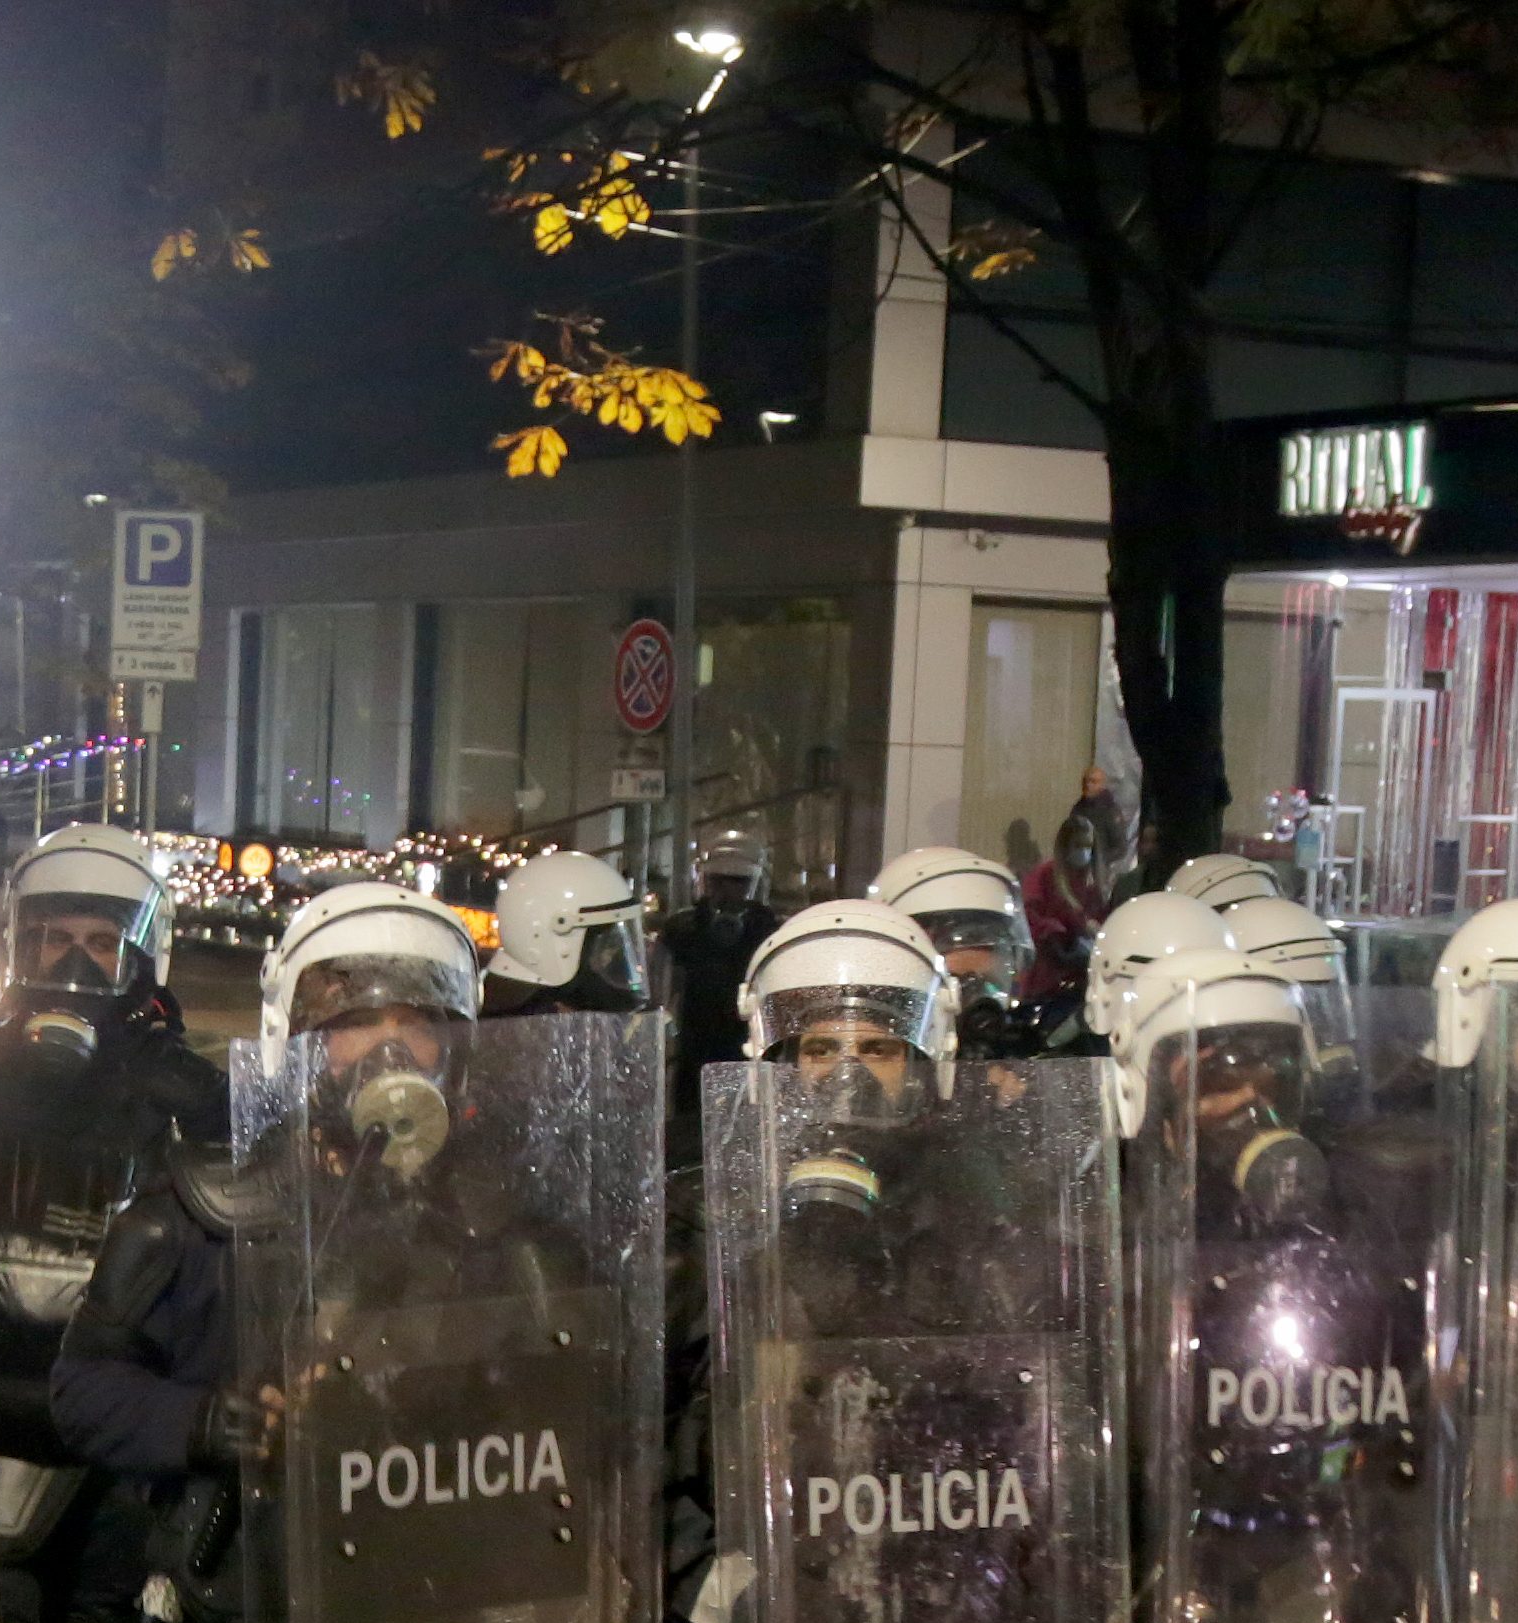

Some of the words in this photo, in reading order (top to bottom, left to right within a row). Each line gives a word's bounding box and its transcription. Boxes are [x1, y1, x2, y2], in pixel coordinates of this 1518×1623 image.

[138, 523, 182, 582] P
[1207, 1364, 1410, 1428] POLICIA
[339, 1428, 568, 1514] POLICIA
[807, 1467, 1032, 1537] POLICIA
